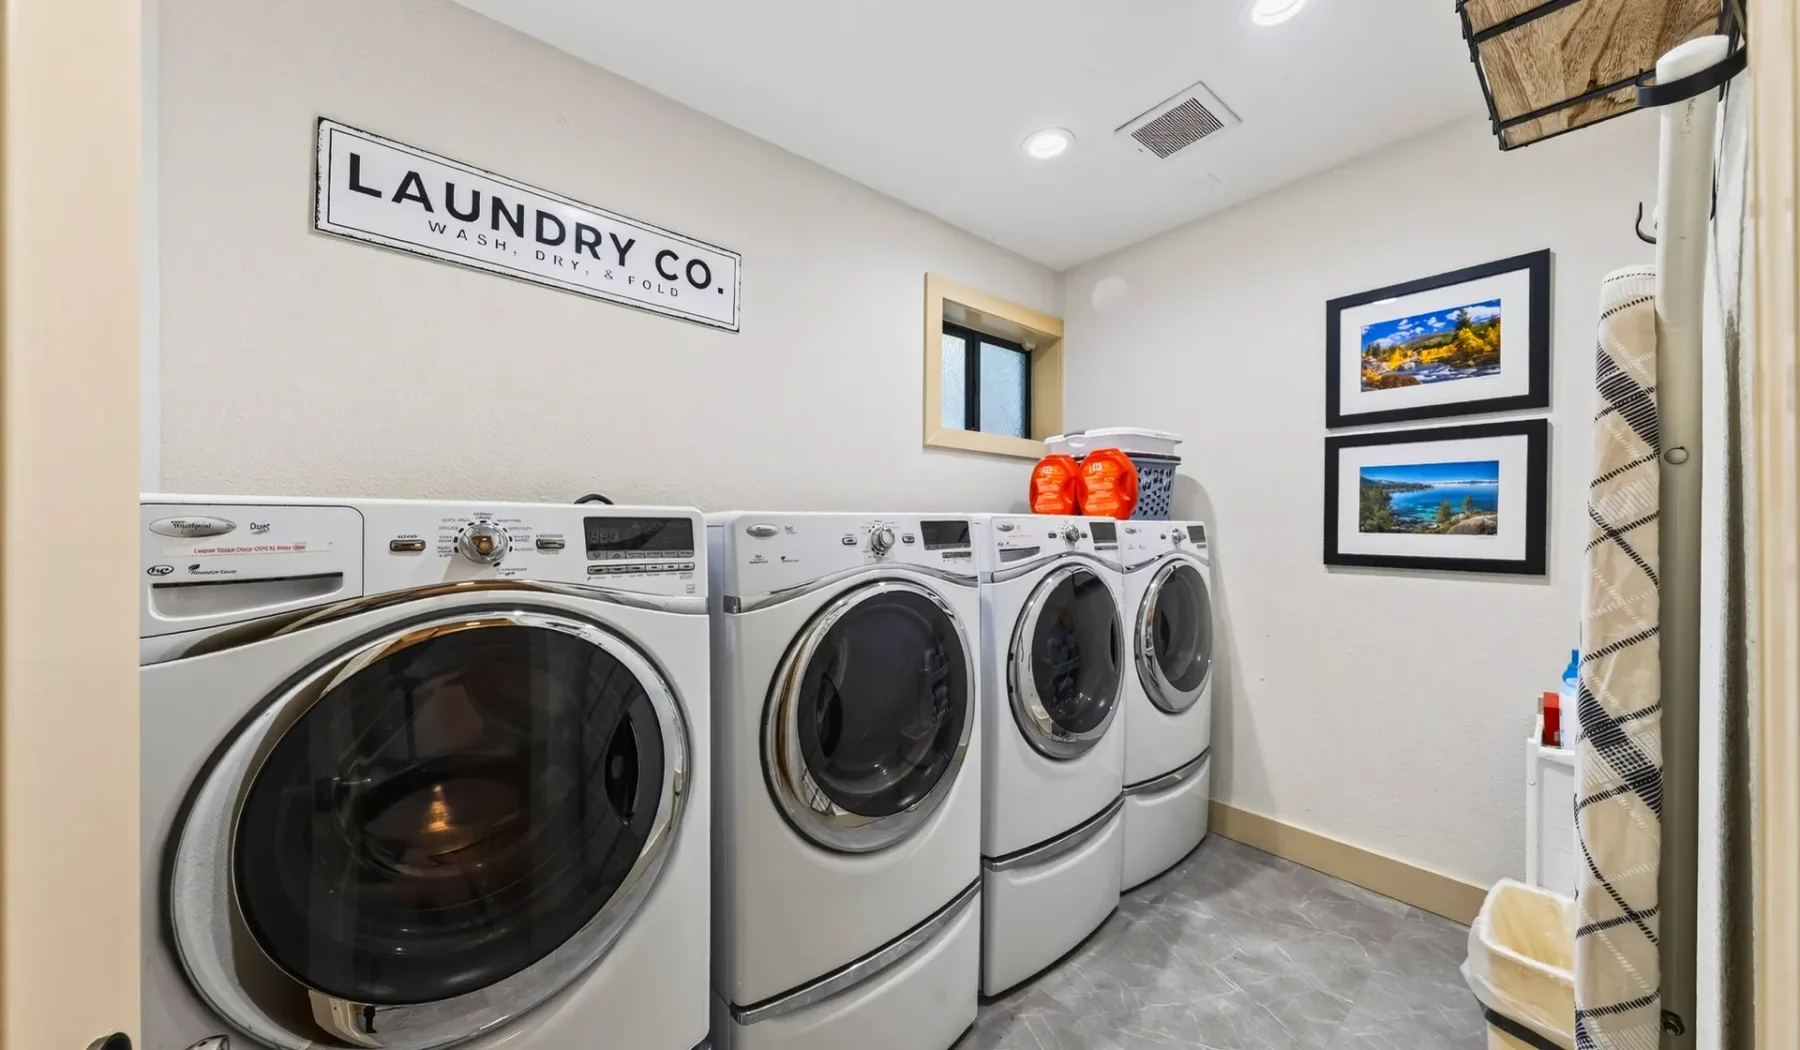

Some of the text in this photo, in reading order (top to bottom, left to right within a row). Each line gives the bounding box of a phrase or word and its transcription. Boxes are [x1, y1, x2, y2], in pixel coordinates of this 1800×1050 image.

[348, 152, 724, 295] LAUNDRY CO.
[427, 220, 679, 297] WASH, DRY, & FOLD
